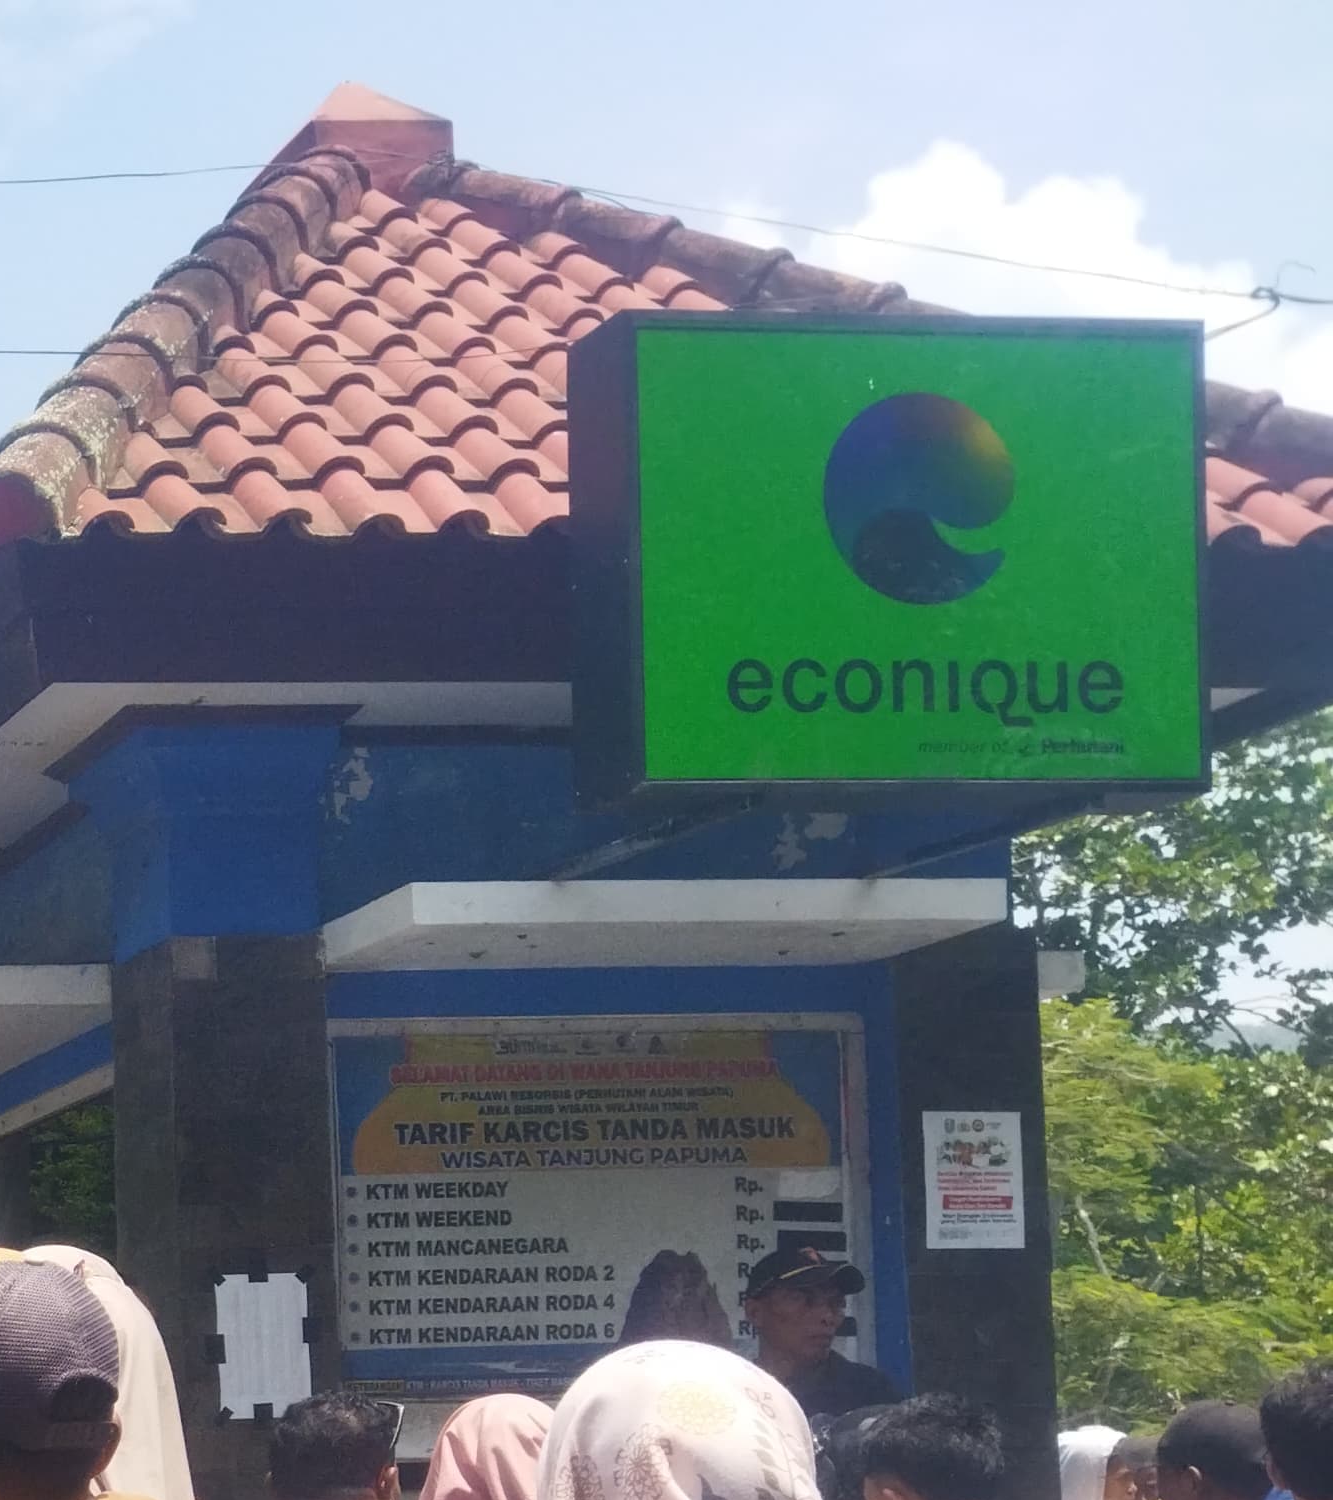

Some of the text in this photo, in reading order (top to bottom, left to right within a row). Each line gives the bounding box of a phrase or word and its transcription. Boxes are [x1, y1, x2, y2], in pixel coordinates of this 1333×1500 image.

[727, 658, 1124, 727] econique
[462, 1090, 507, 1102] PALAWI
[394, 1116, 794, 1145] TARIF KARCIS TANDA MASUK
[441, 1146, 748, 1168] WISATA TANJUNG PAPUMA
[366, 1176, 763, 1200] KTM WEEKDAY Rp.
[367, 1204, 765, 1229] KTM WEEKEND Rp.
[368, 1234, 766, 1258] KTM MANCANEGARA Rp.
[369, 1265, 615, 1287] KTM KENDARAAN RODA 2
[369, 1294, 615, 1316] KTM KENDARAAN RODA 4
[370, 1323, 615, 1345] KTM KENDARAAN RODA 6
